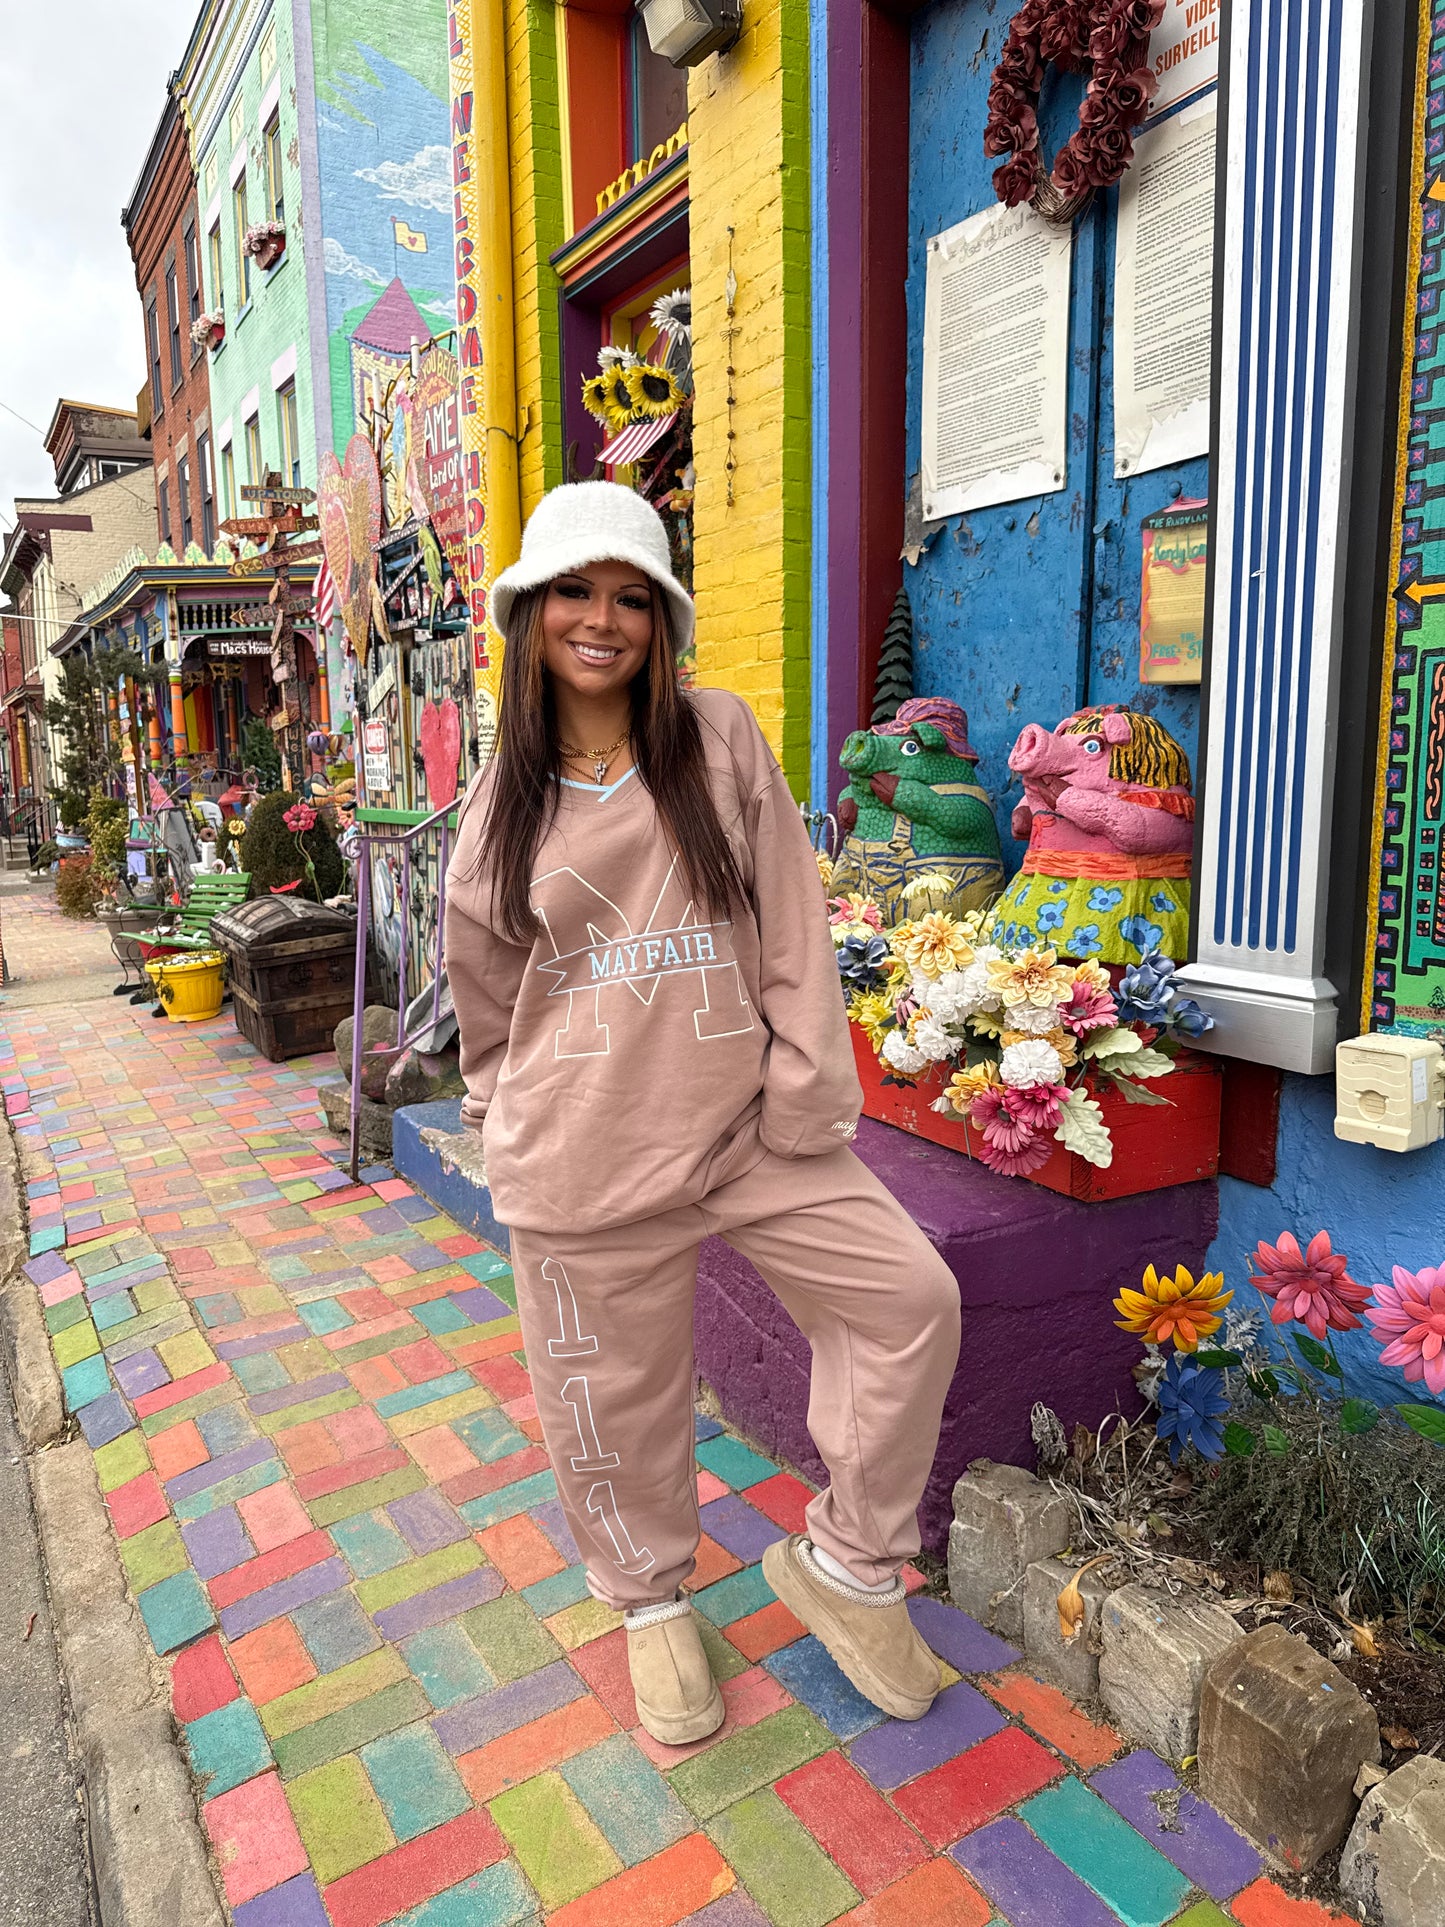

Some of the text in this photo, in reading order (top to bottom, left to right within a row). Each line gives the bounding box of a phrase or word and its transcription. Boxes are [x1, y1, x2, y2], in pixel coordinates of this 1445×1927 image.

[1186, 0, 1221, 28] VIDE
[451, 91, 483, 415] WELCOME
[1149, 517, 1165, 529] THE
[461, 451, 490, 670] HOUSE
[588, 931, 717, 981] MAYFAIR
